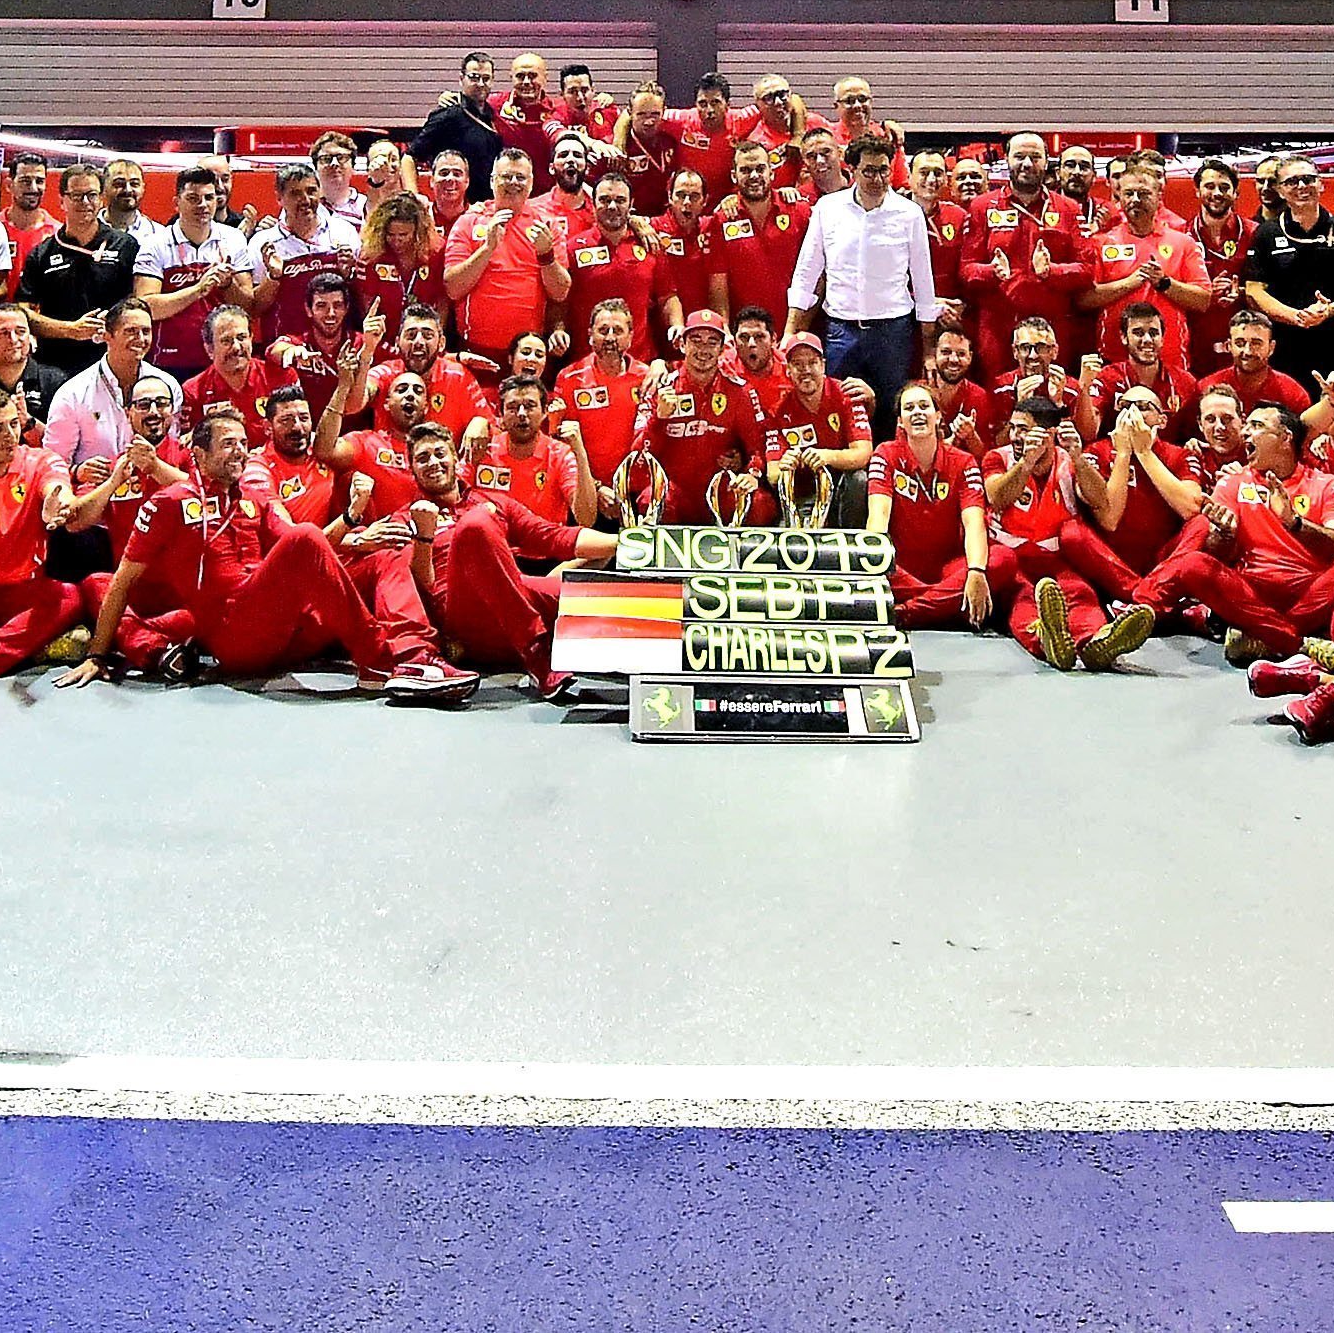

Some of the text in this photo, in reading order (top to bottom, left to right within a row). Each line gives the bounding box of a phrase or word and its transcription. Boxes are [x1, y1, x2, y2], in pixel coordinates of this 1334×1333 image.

[617, 527, 896, 574] SNG 2019
[688, 575, 890, 625] SEB P1
[684, 623, 914, 677] CHARLES P2
[719, 698, 823, 715] #essereFerrari
